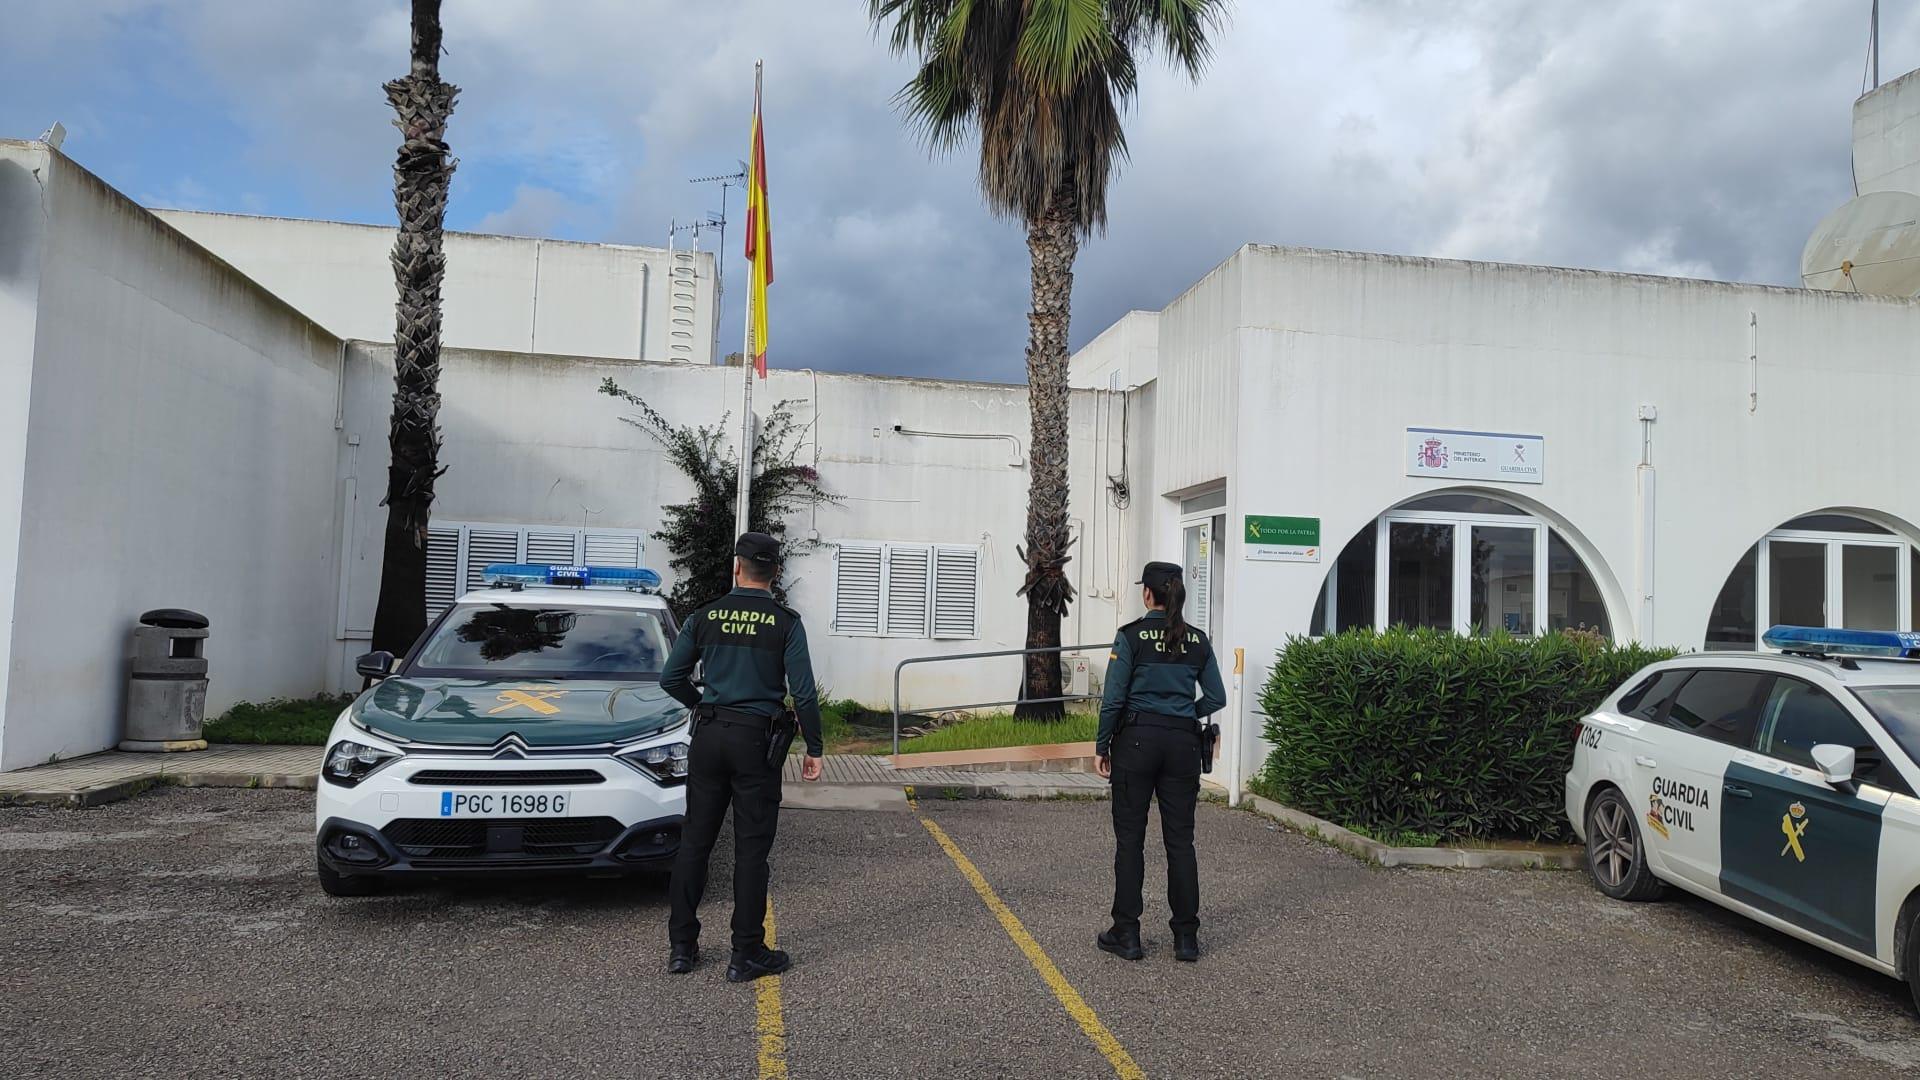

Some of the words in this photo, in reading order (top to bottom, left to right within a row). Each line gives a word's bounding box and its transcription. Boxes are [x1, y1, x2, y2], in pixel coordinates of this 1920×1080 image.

[707, 609, 776, 626] GUARDIA
[721, 622, 757, 635] CIVIL
[1139, 629, 1200, 644] GUAIA
[1155, 642, 1187, 654] CIL
[1652, 776, 1709, 810] GUARDIA
[455, 794, 494, 813] PGC
[501, 795, 548, 813] 1698
[552, 795, 566, 813] G
[1663, 805, 1695, 832] CIVIL
